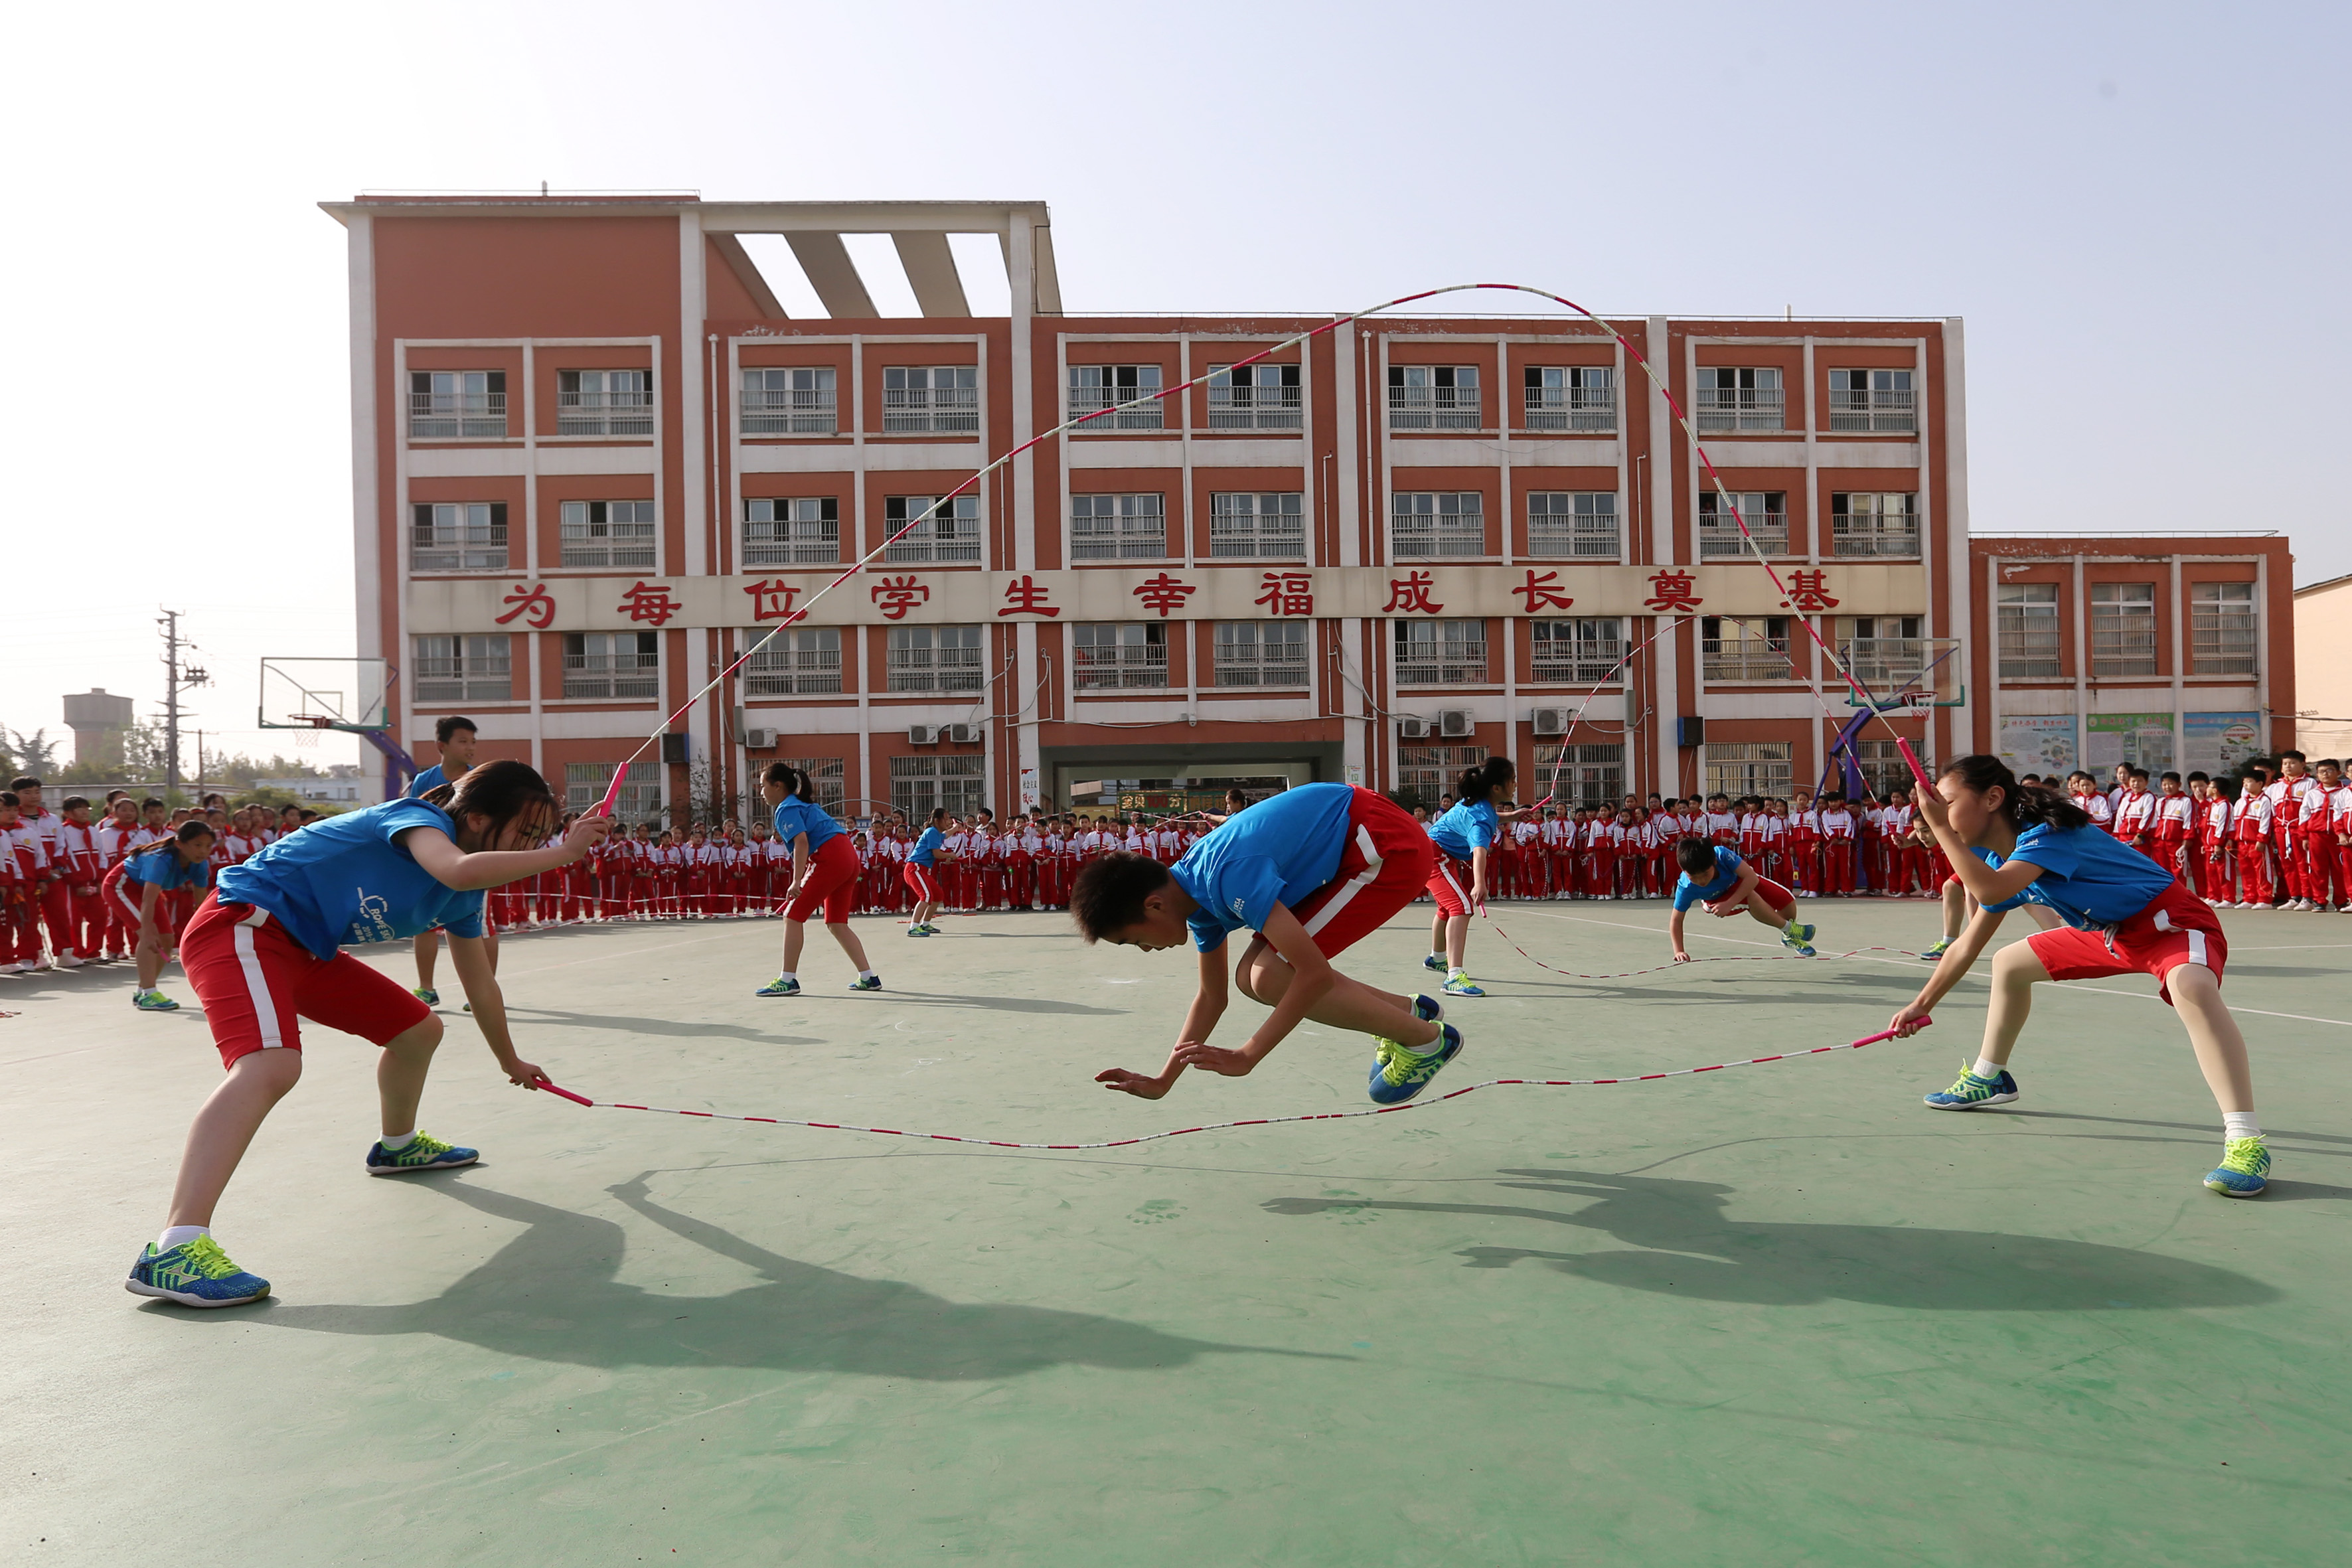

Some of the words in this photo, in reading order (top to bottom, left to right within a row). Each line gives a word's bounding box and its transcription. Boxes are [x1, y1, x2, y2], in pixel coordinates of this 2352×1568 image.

[495, 568, 1840, 629] 为每位学生幸福成长奠基
[370, 908, 386, 931] ROPE
